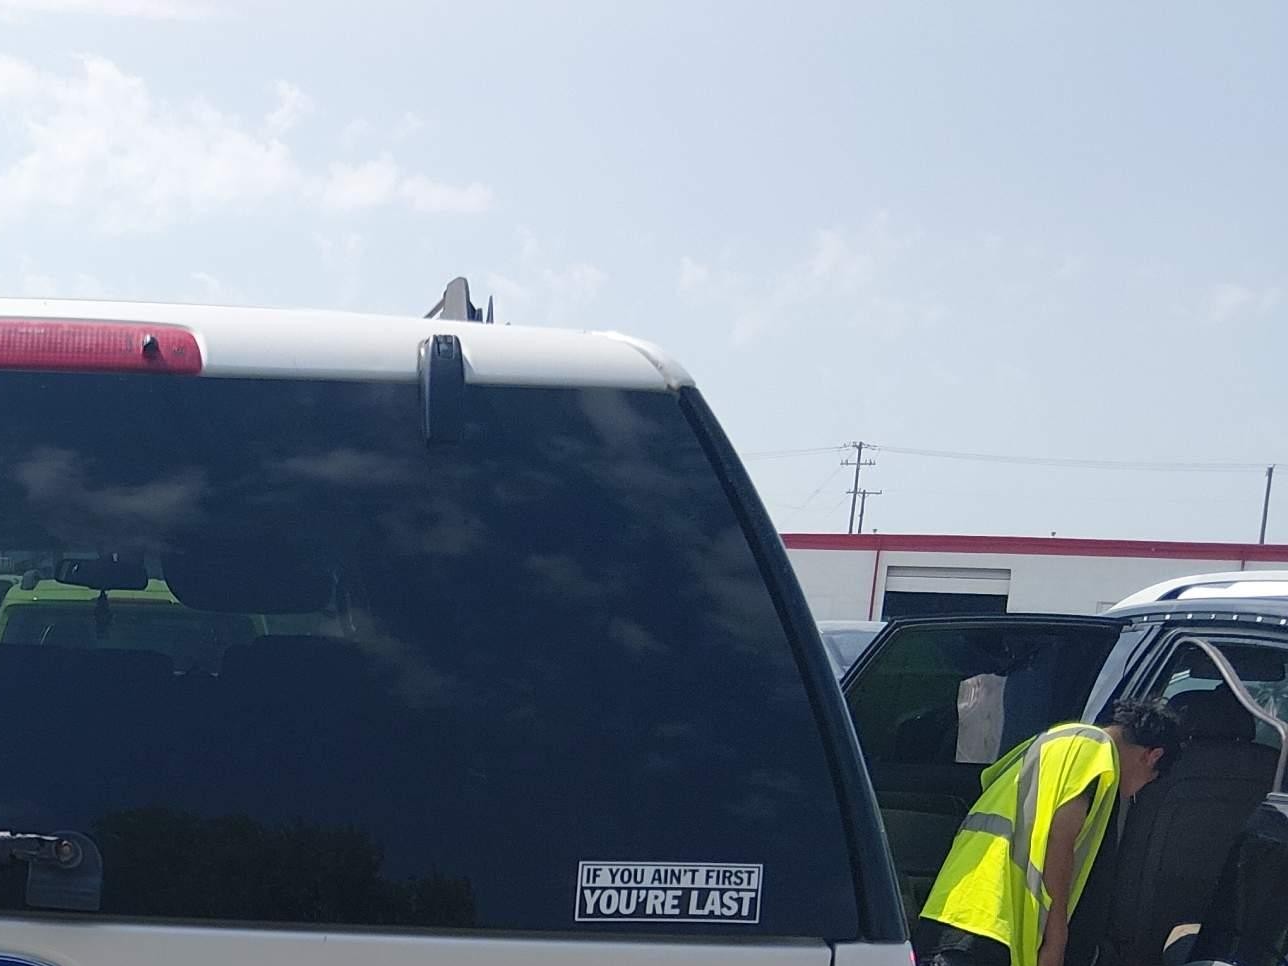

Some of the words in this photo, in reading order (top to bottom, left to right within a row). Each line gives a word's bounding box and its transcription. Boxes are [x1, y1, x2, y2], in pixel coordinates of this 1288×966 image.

[585, 868, 603, 884] IF
[608, 868, 645, 885] YOU
[650, 869, 699, 886] AIN'T
[704, 870, 755, 887] FIRST
[584, 889, 682, 915] YOU'RE
[688, 891, 756, 917] LAST
